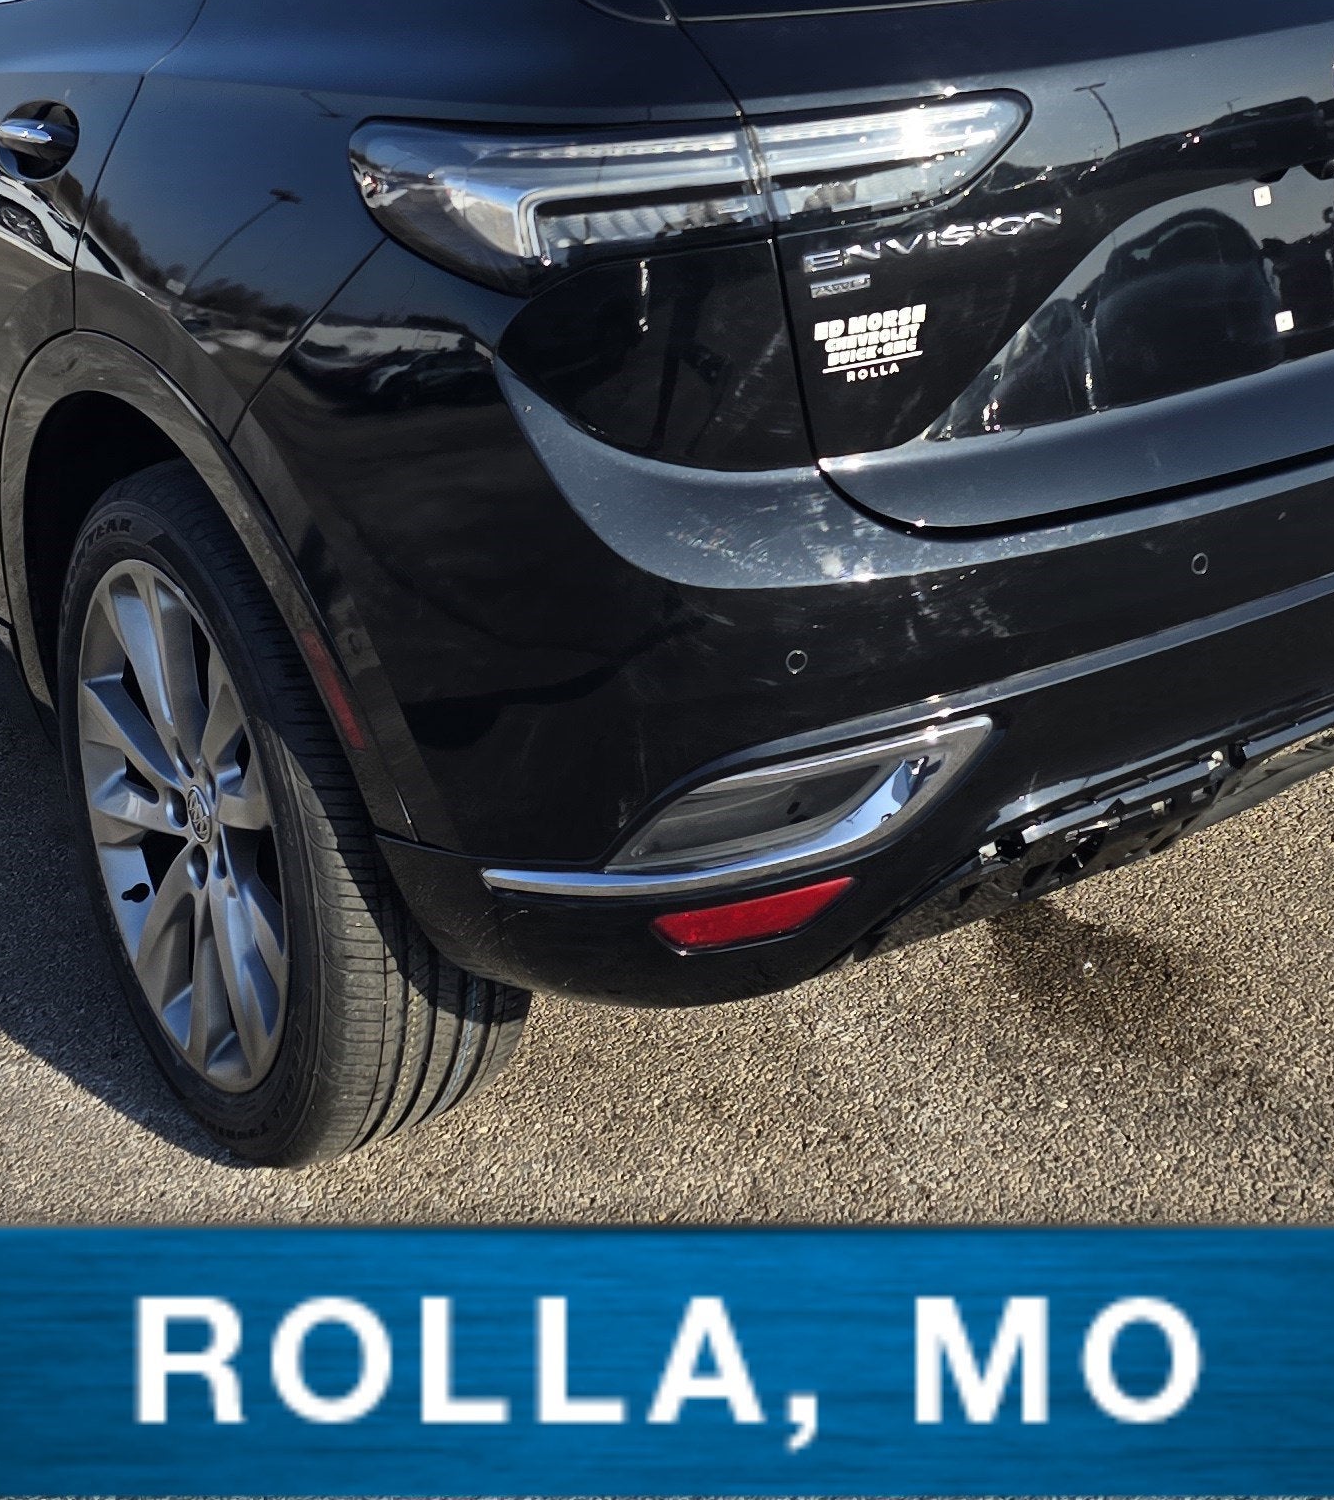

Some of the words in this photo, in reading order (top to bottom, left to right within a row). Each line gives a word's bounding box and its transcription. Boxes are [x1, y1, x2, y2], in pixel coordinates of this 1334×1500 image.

[803, 206, 1063, 273] ENVISION
[825, 322, 921, 353] CHEVROLET
[846, 362, 900, 383] ROLLA
